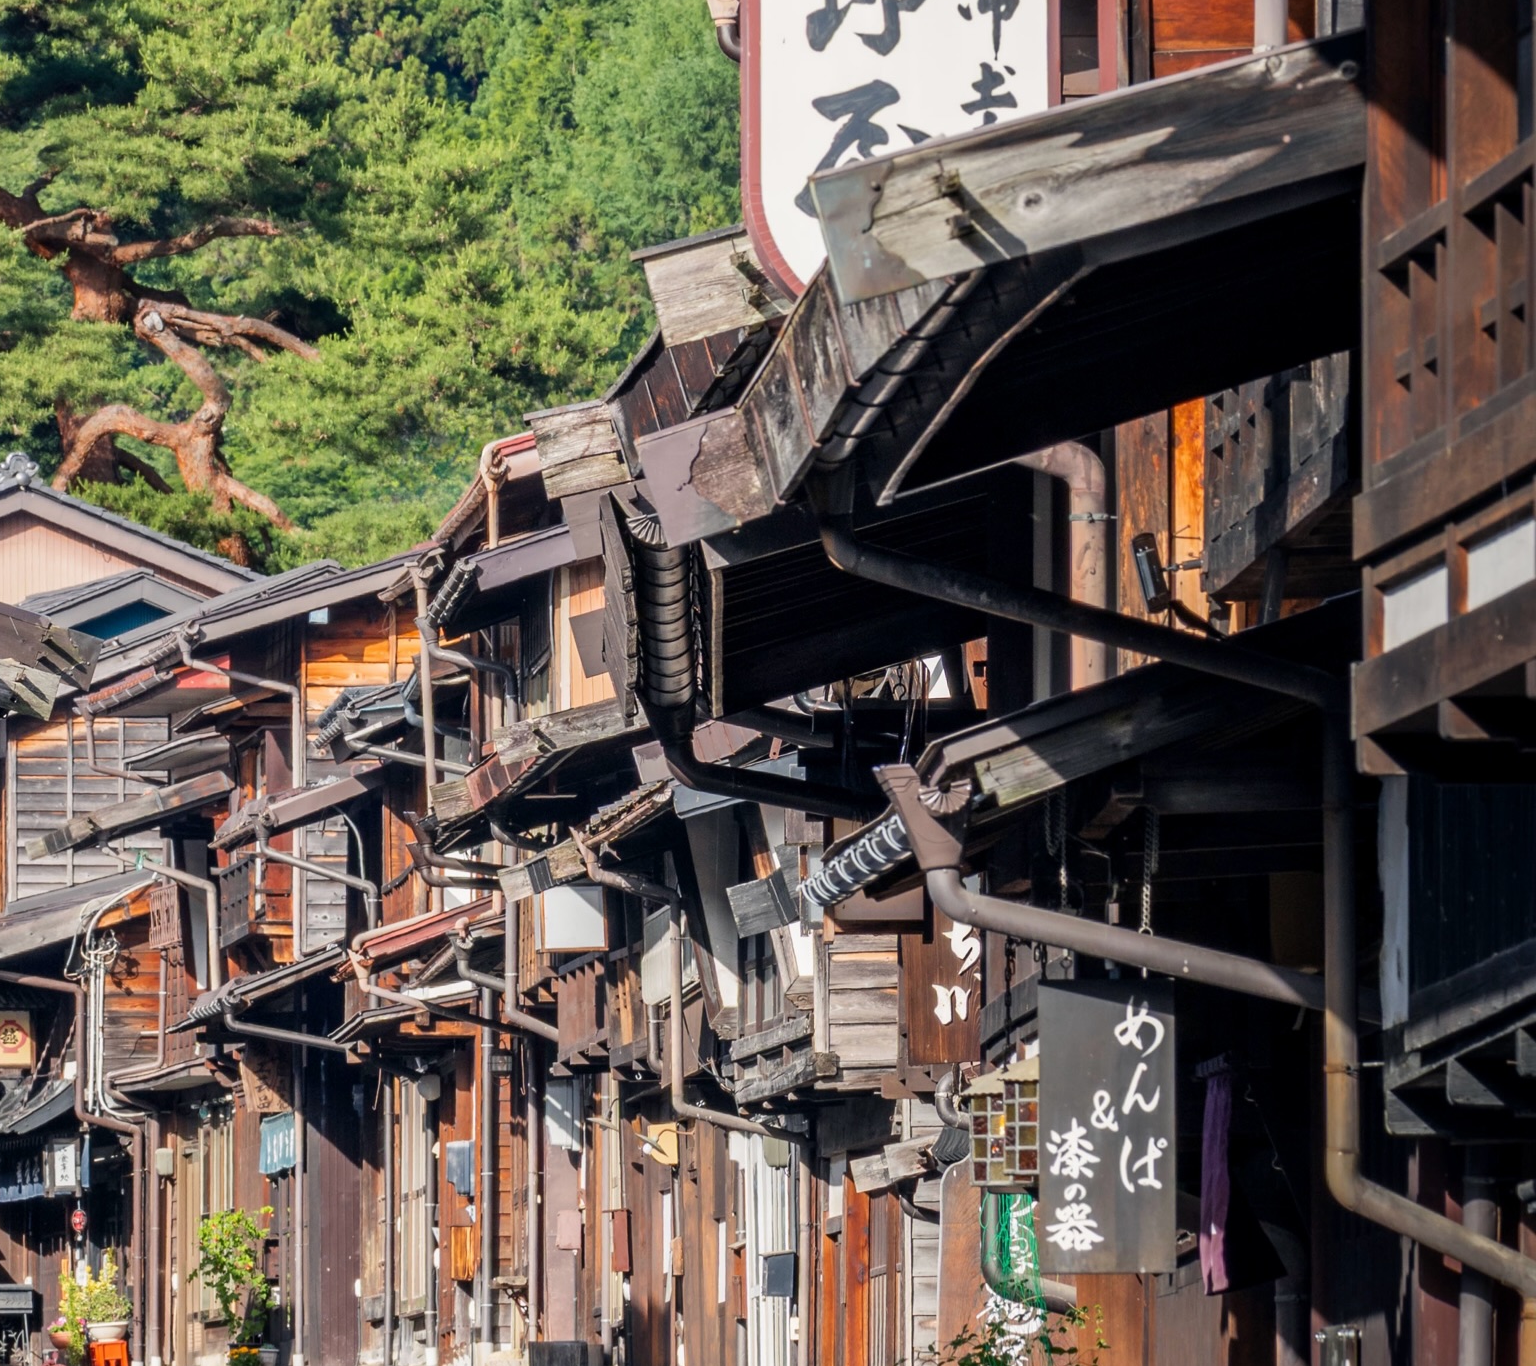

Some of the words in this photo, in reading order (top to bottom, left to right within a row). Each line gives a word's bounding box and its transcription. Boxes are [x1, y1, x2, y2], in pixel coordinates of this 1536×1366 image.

[1113, 996, 1169, 1193] めんぱ
[1045, 1117, 1105, 1253] 漆の器
